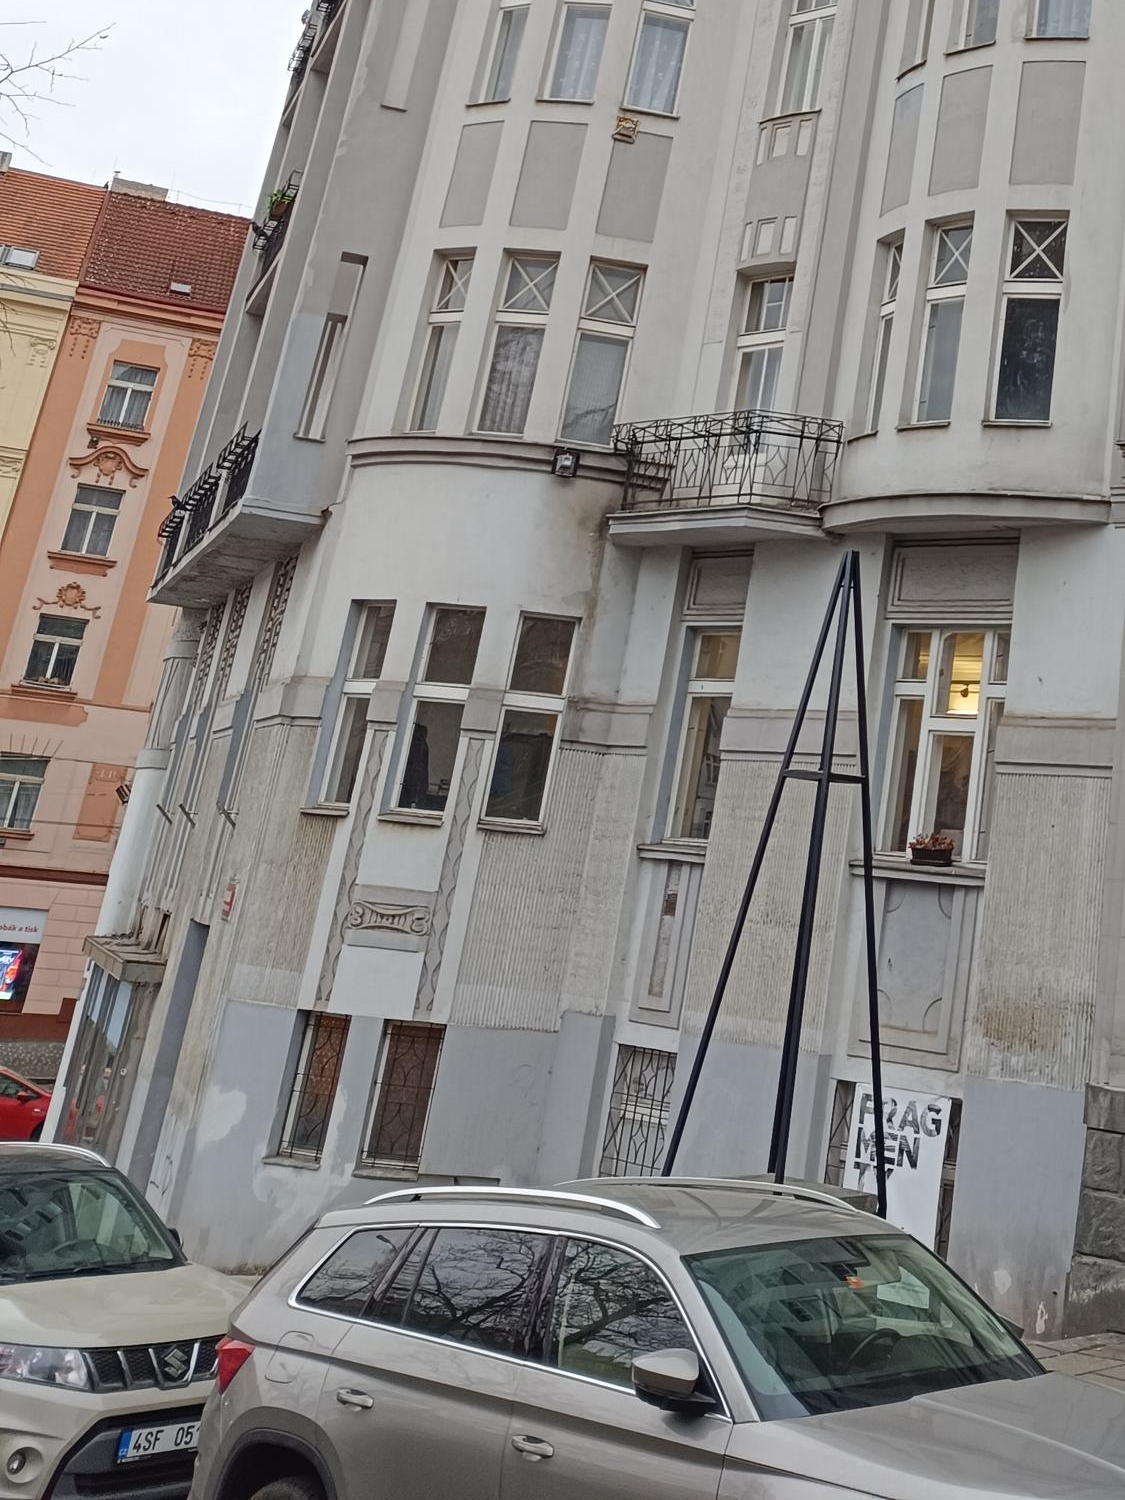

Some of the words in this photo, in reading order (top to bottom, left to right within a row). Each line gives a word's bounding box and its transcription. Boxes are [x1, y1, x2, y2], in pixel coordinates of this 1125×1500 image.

[859, 1093, 942, 1137] FRAG
[855, 1127, 920, 1169] MEN
[133, 1430, 164, 1452] 4SF
[174, 1424, 200, 1447] 05
